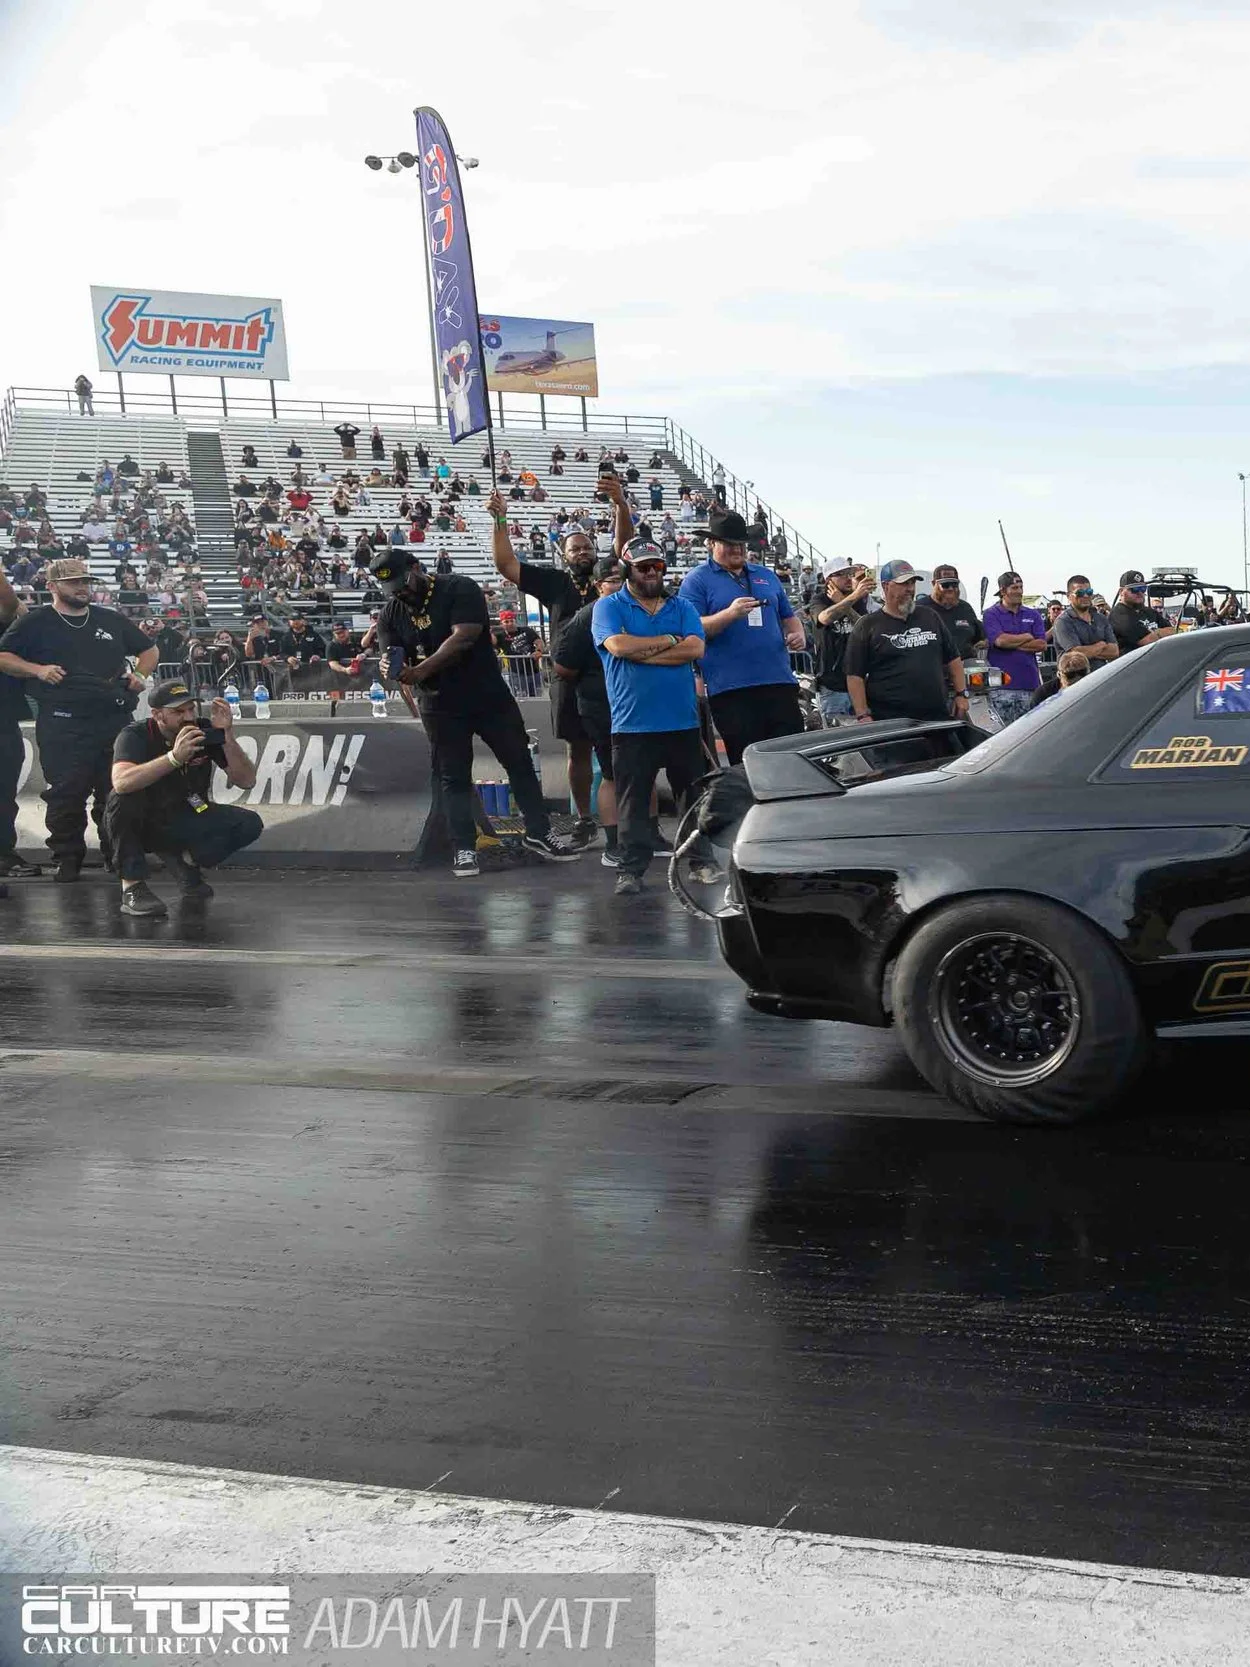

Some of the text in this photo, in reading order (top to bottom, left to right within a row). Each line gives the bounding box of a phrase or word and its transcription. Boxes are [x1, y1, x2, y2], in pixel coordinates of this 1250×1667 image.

[130, 355, 264, 370] RACING EQUIPMENT
[1171, 738, 1207, 748] ROB
[1133, 748, 1242, 764] MARJAN
